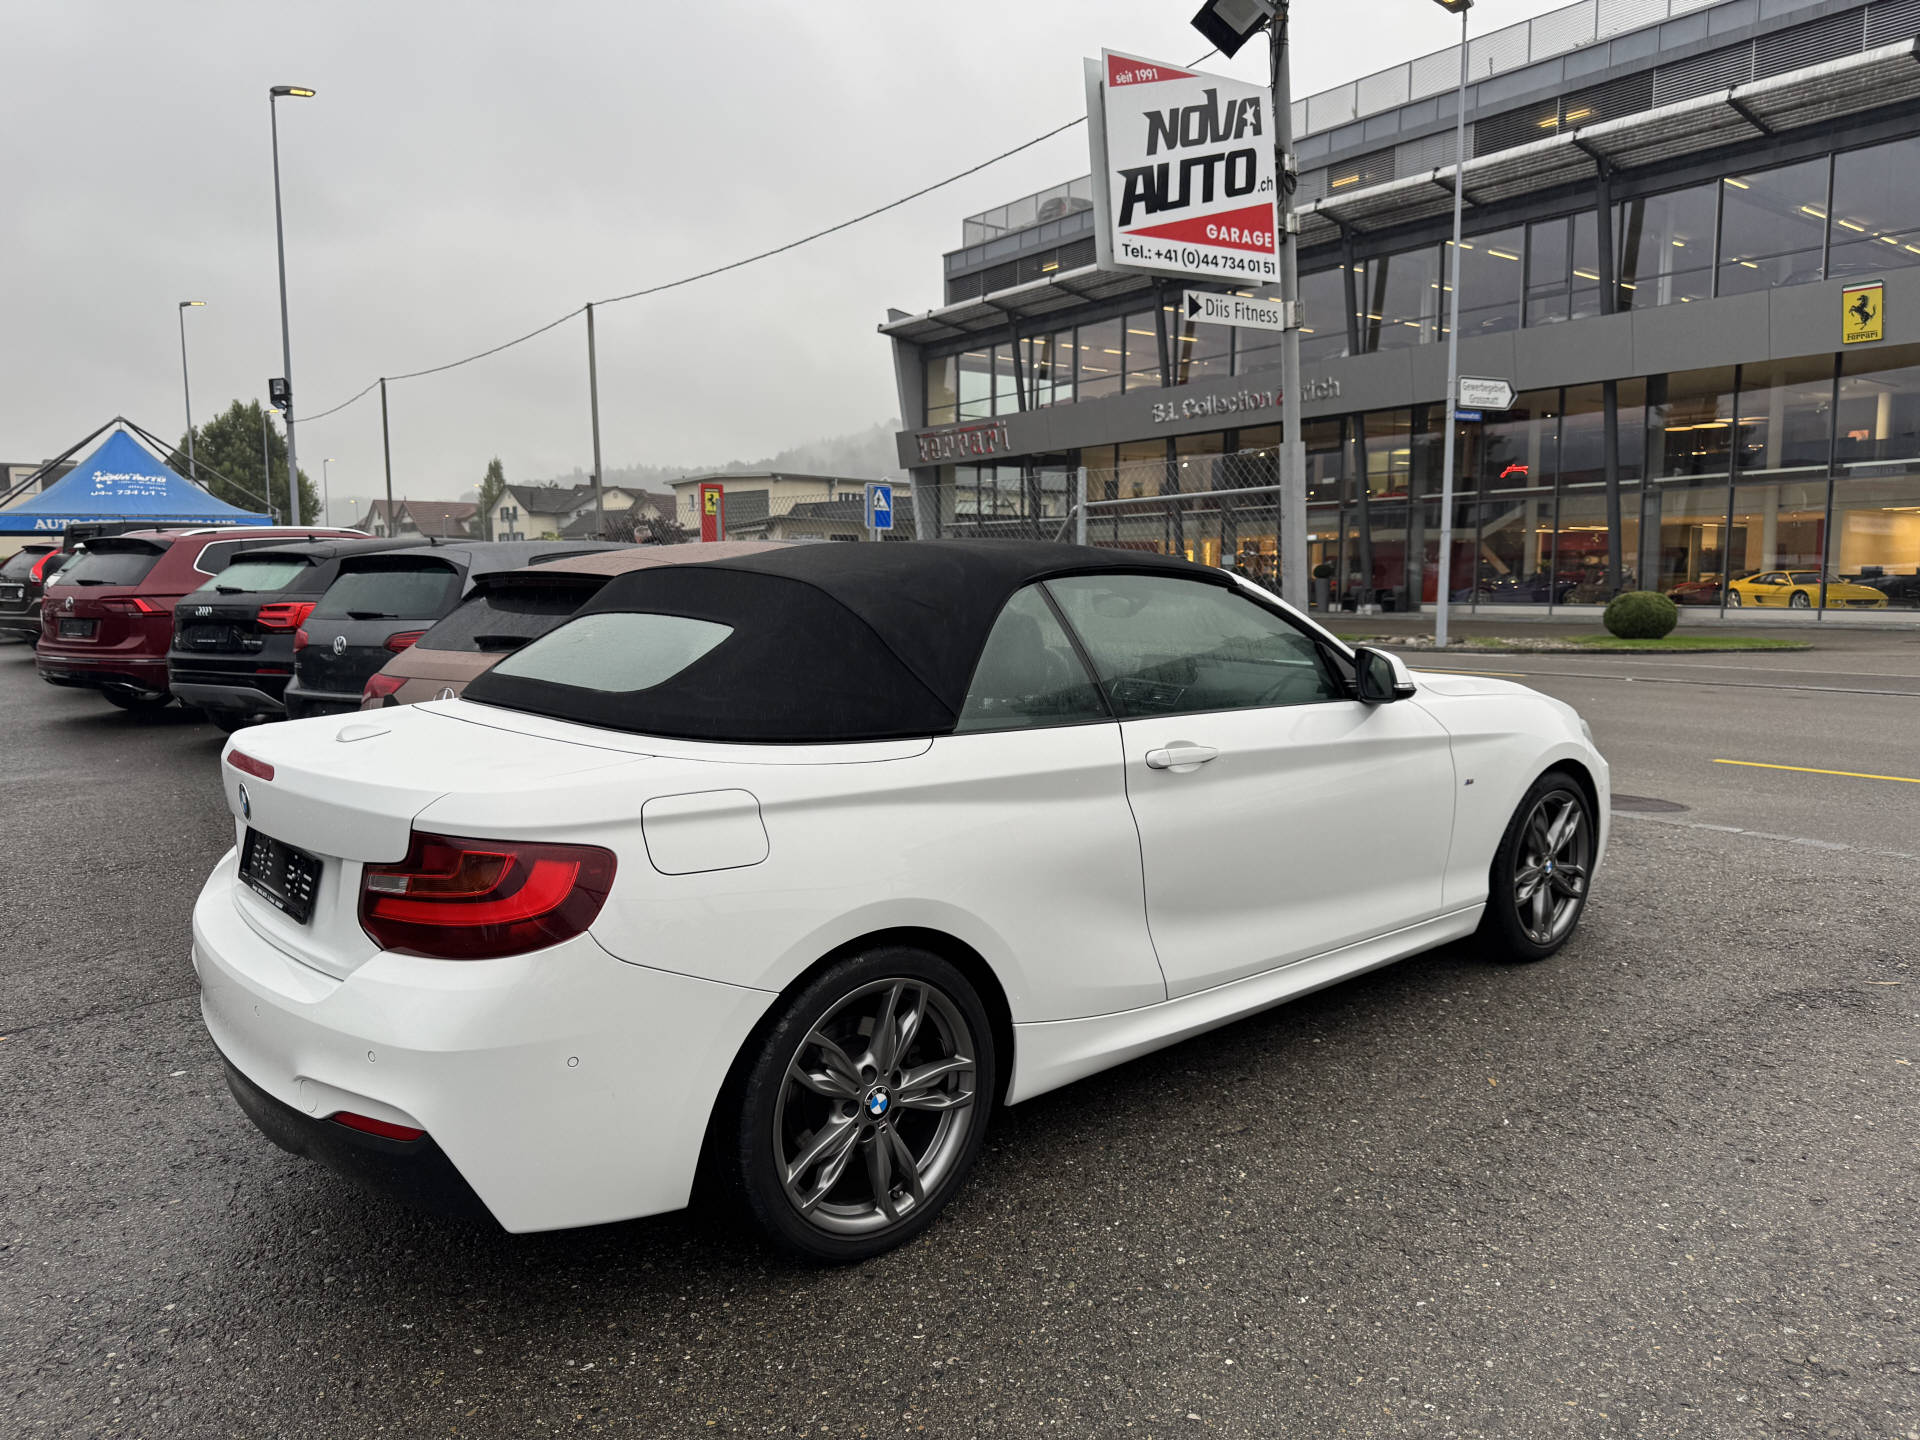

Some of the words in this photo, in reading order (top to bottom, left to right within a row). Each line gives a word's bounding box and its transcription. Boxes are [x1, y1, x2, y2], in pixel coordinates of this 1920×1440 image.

[1115, 70, 1133, 84] seit
[1135, 68, 1159, 81] 1991
[1142, 88, 1262, 156] NOVA
[1206, 223, 1272, 248] GARAGE
[1121, 243, 1152, 260] Tel.:
[1155, 249, 1178, 262] +41
[1222, 256, 1245, 271] 734
[1248, 260, 1260, 272] 01
[1263, 261, 1276, 274] 51
[1206, 298, 1230, 319] Diis
[1235, 302, 1279, 324] Fitness
[1846, 330, 1878, 341] Ferrari
[1182, 390, 1272, 418] Collection
[1276, 376, 1341, 407] Zrich
[915, 419, 1010, 462] Ferrari
